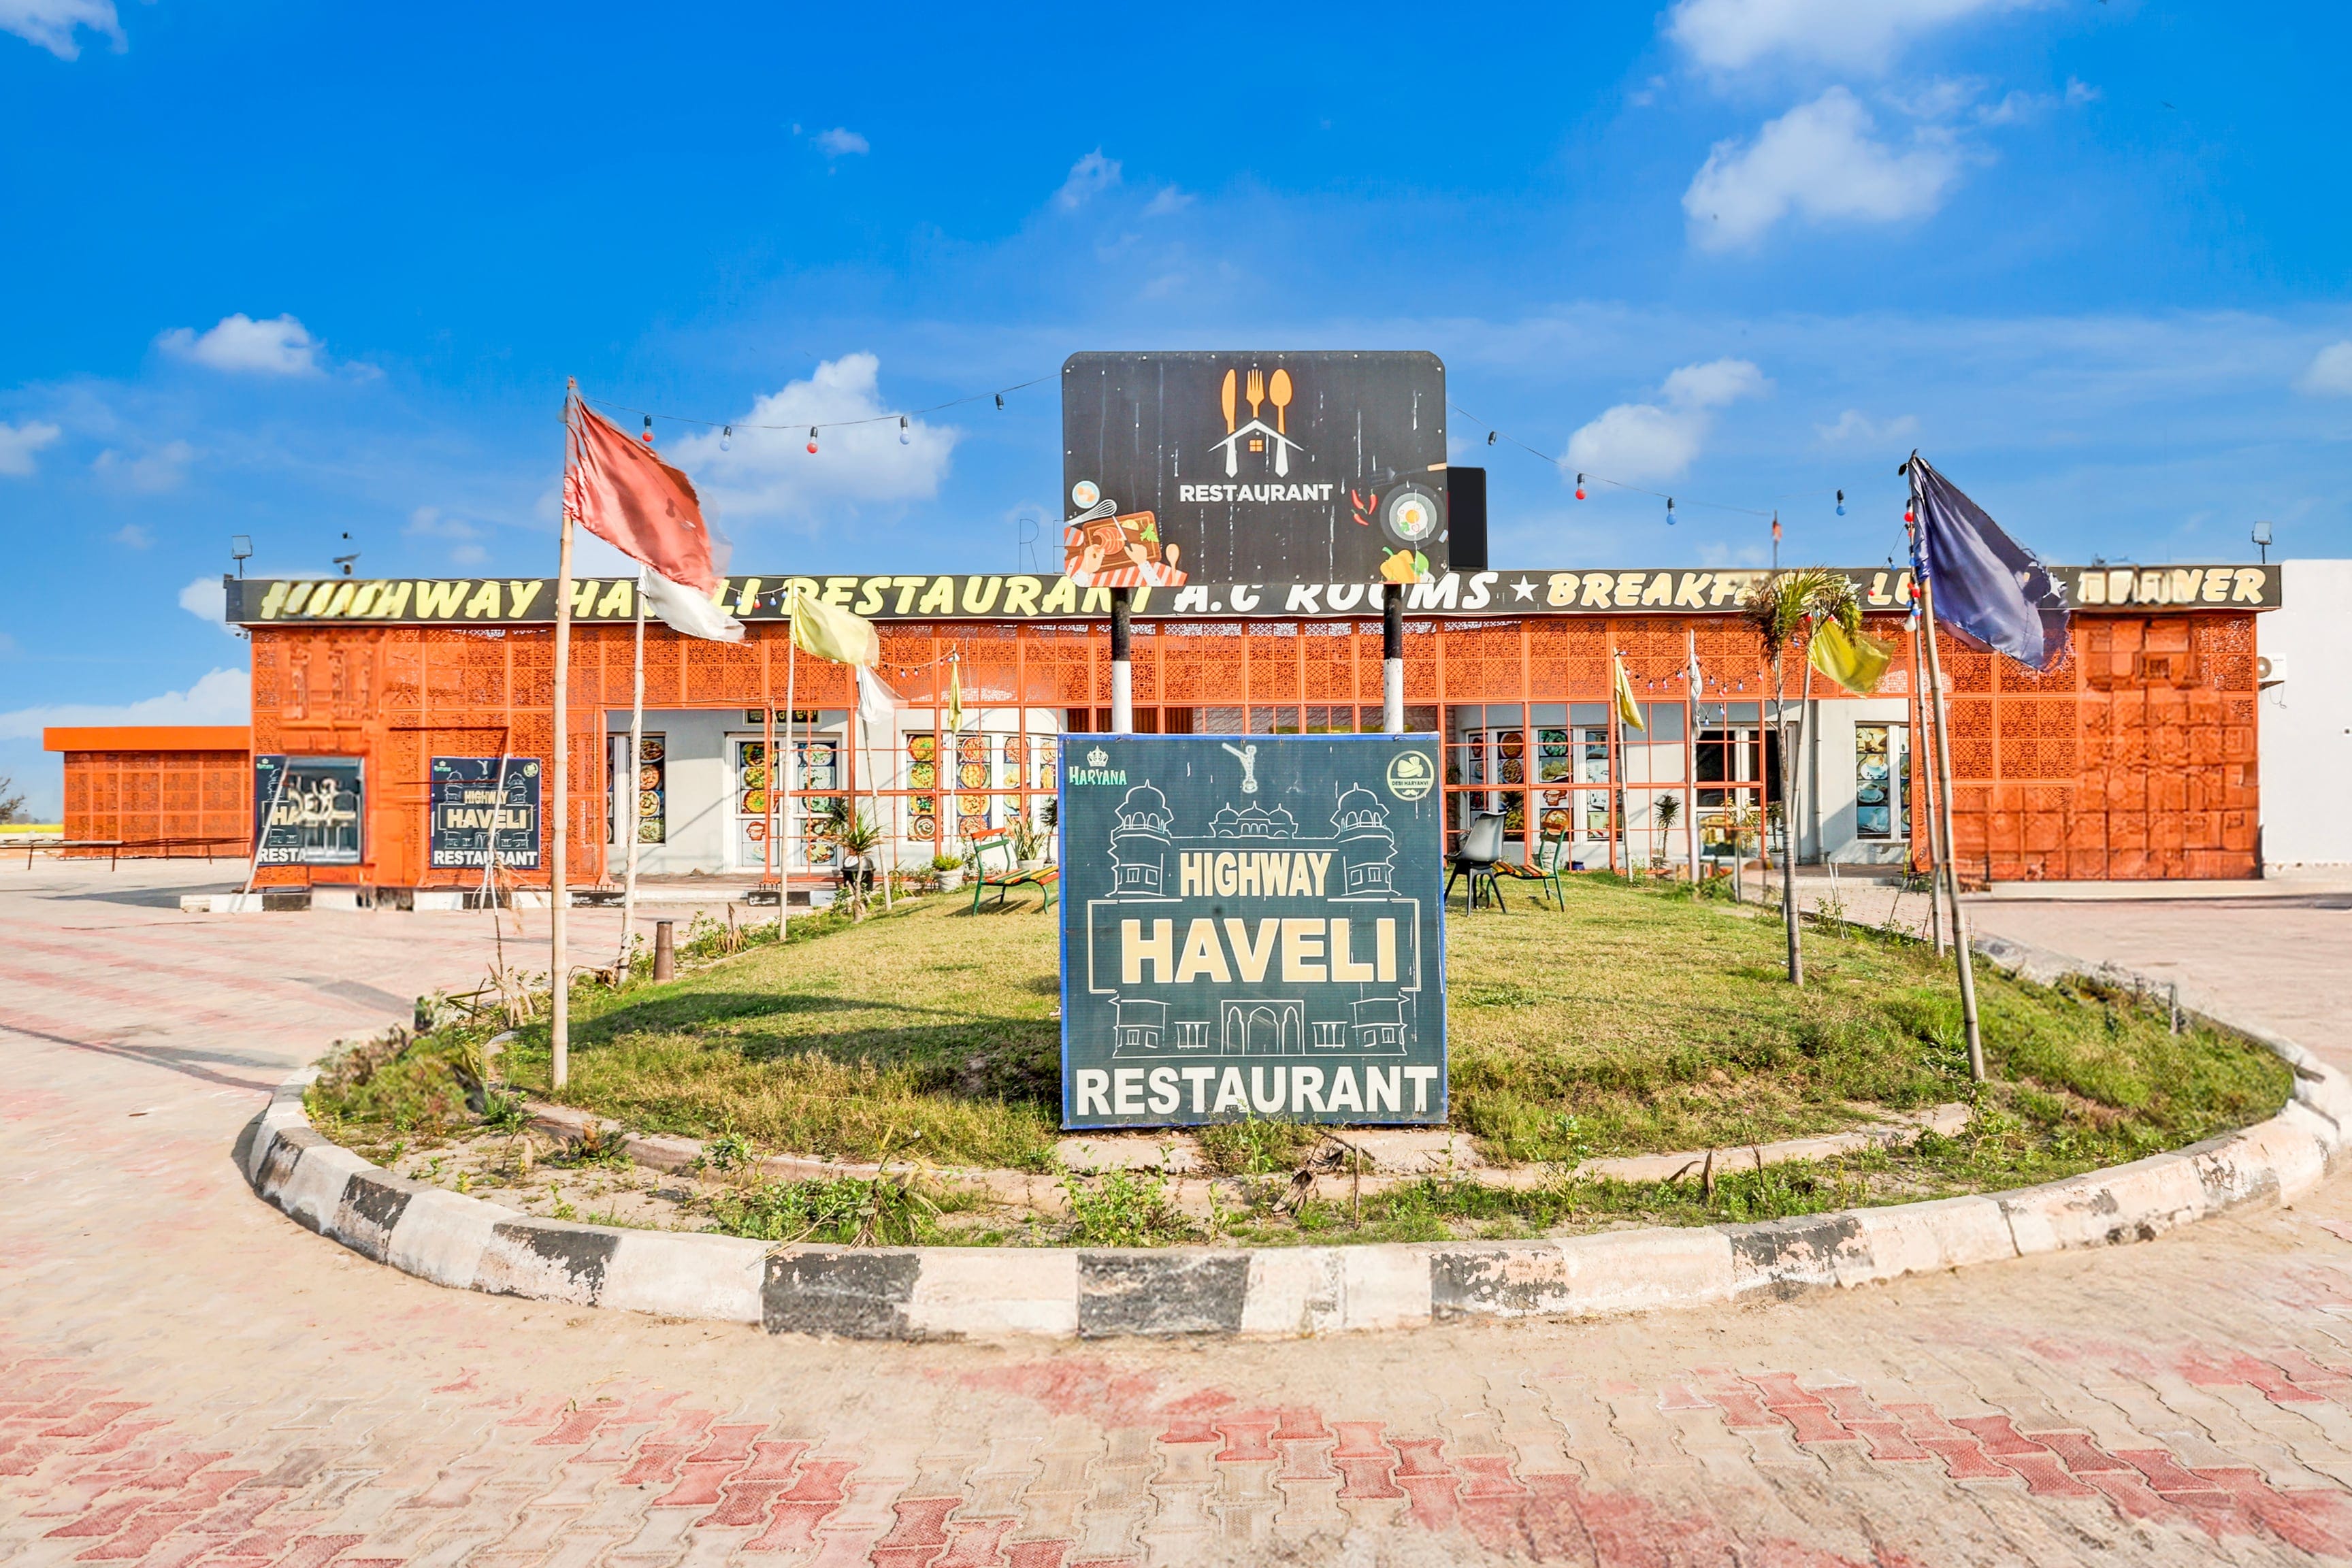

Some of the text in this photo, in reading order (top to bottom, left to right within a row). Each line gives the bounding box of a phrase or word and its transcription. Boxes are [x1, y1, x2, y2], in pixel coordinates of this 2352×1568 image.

[1179, 484, 1333, 505] RESTAURANT
[261, 581, 543, 619] HHWAY
[555, 578, 763, 617] HALI
[1173, 585, 1263, 613] A.C
[1546, 572, 1829, 610] BREAKF
[1068, 766, 1127, 787] HARYANA
[464, 790, 510, 804] HIGHWY
[446, 808, 527, 829] HAVELI
[1179, 852, 1331, 897] HIGHWAY
[1120, 917, 1397, 984] HAVELI
[1075, 1065, 1438, 1116] RESTAURANT
